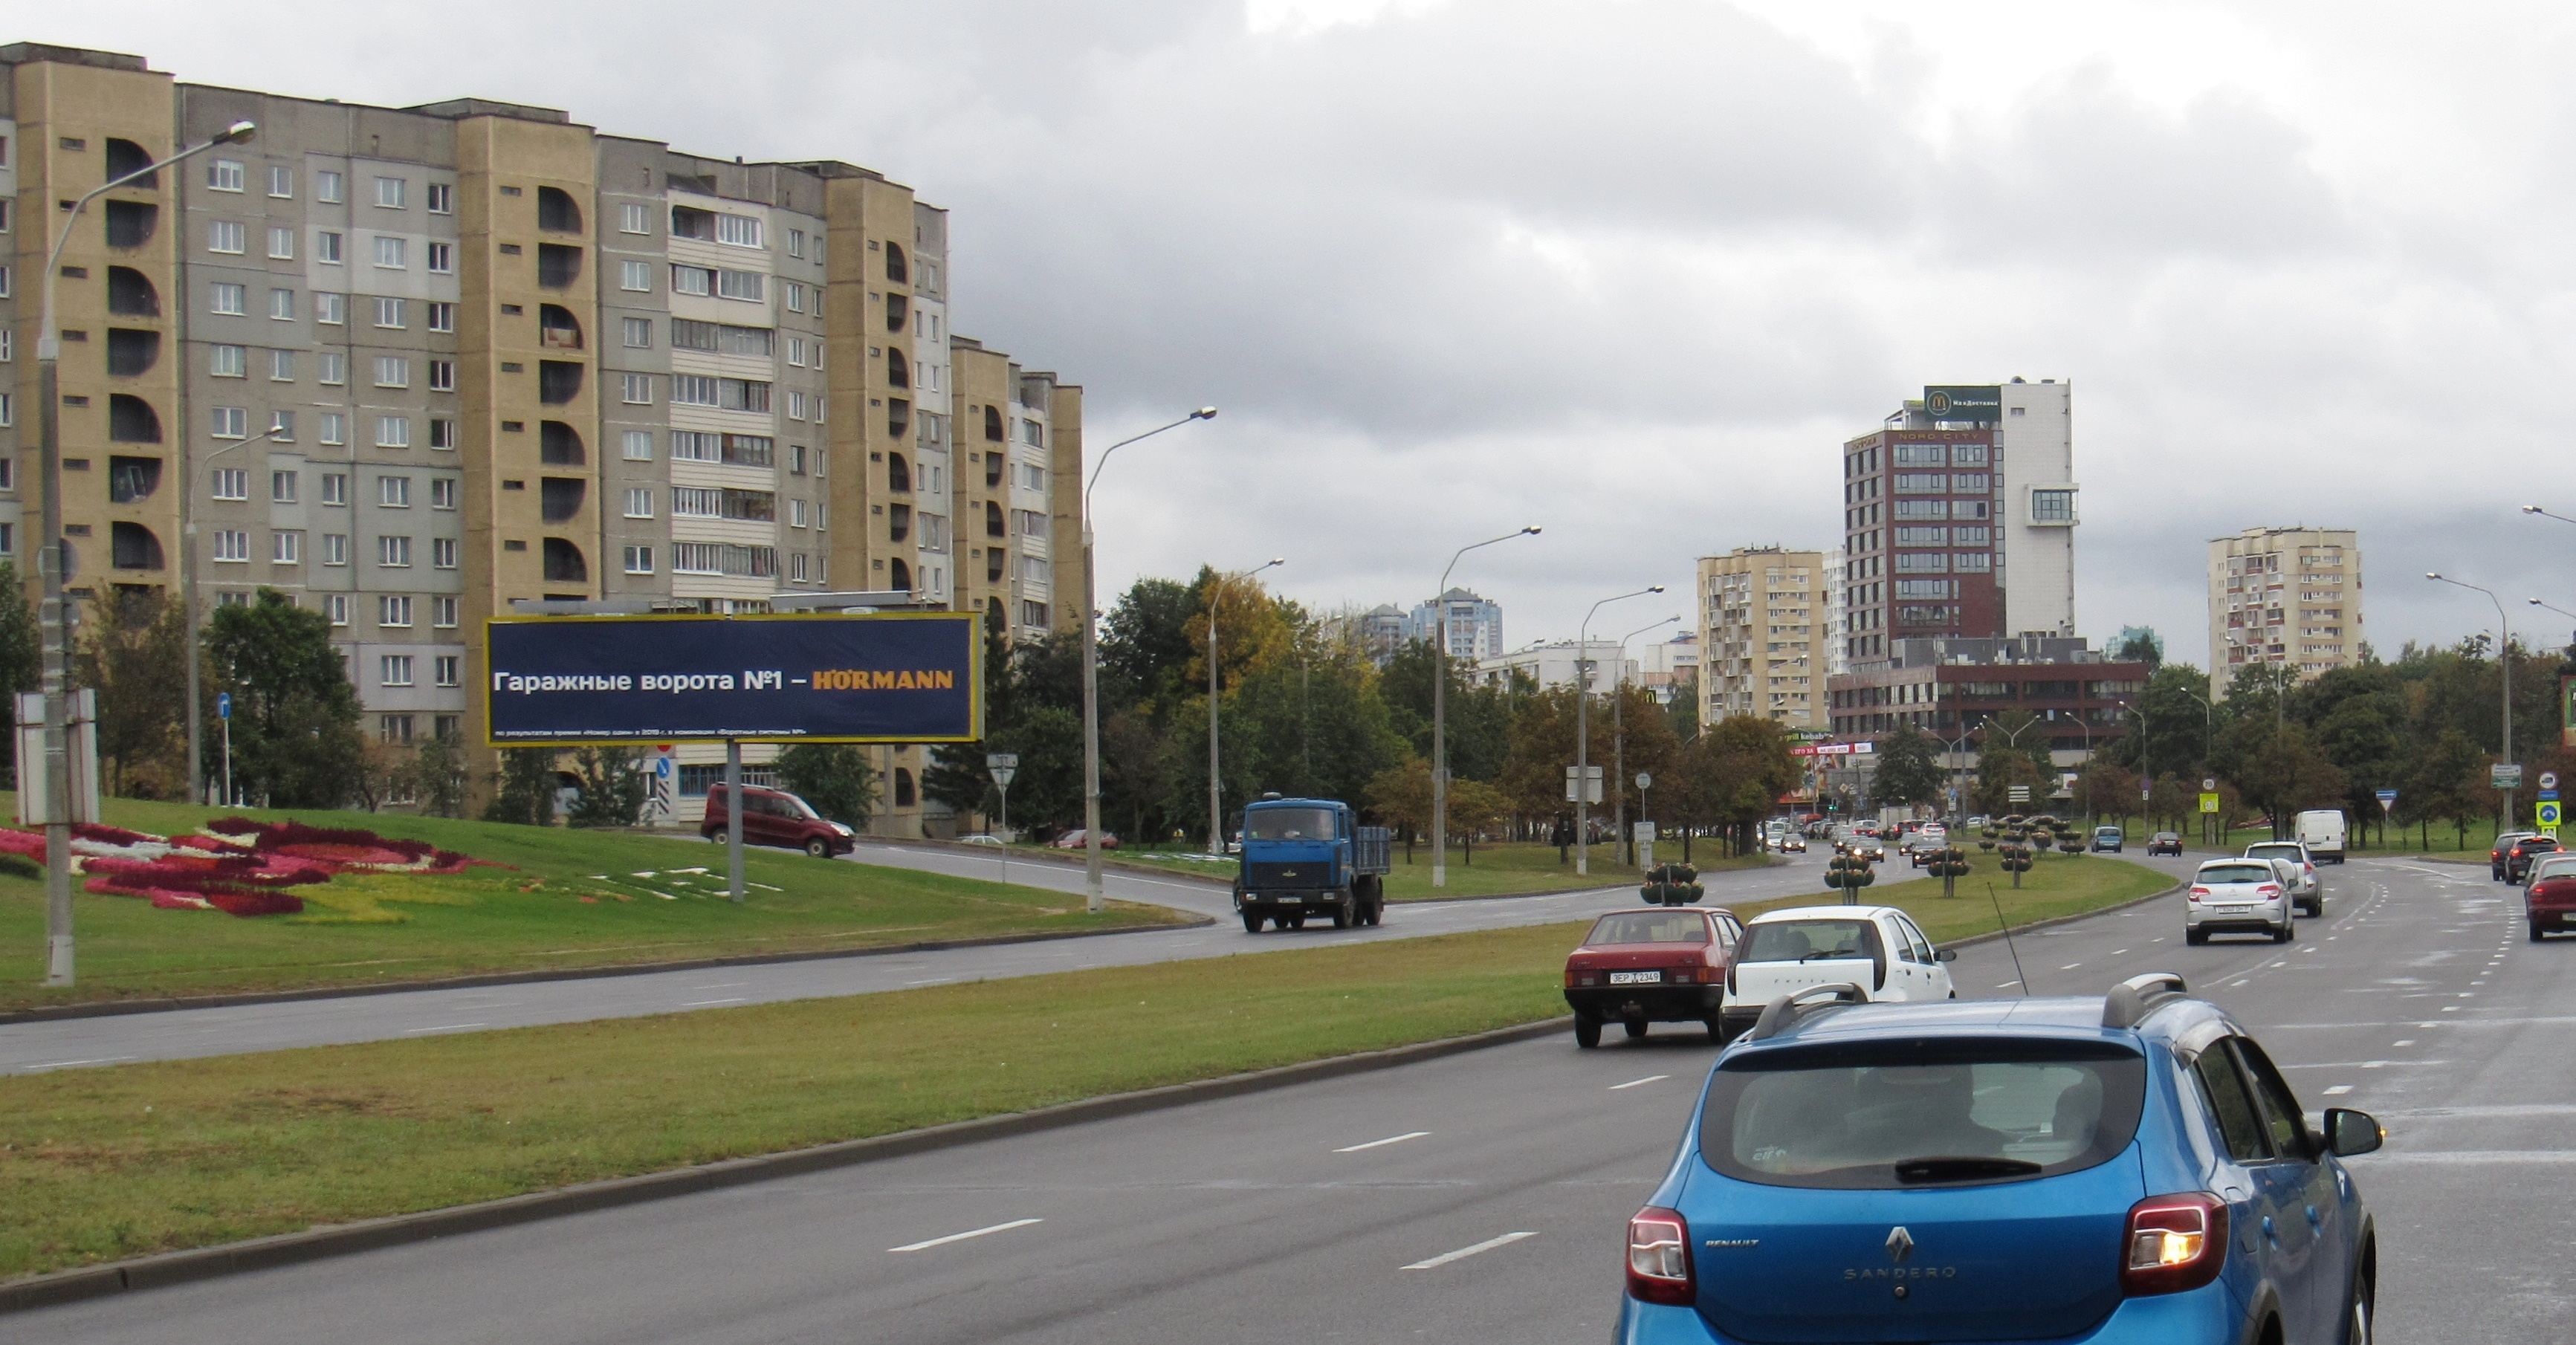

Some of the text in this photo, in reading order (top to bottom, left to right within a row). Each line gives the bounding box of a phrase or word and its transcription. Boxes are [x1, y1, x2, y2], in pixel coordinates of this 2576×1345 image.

[494, 672, 632, 695] Гаражные
[641, 673, 734, 694] ворота
[745, 670, 783, 690] №1
[812, 669, 954, 690] HÖRMANN
[1706, 1239, 1759, 1248] RENAULT
[1844, 1266, 1956, 1280] SANDERO
